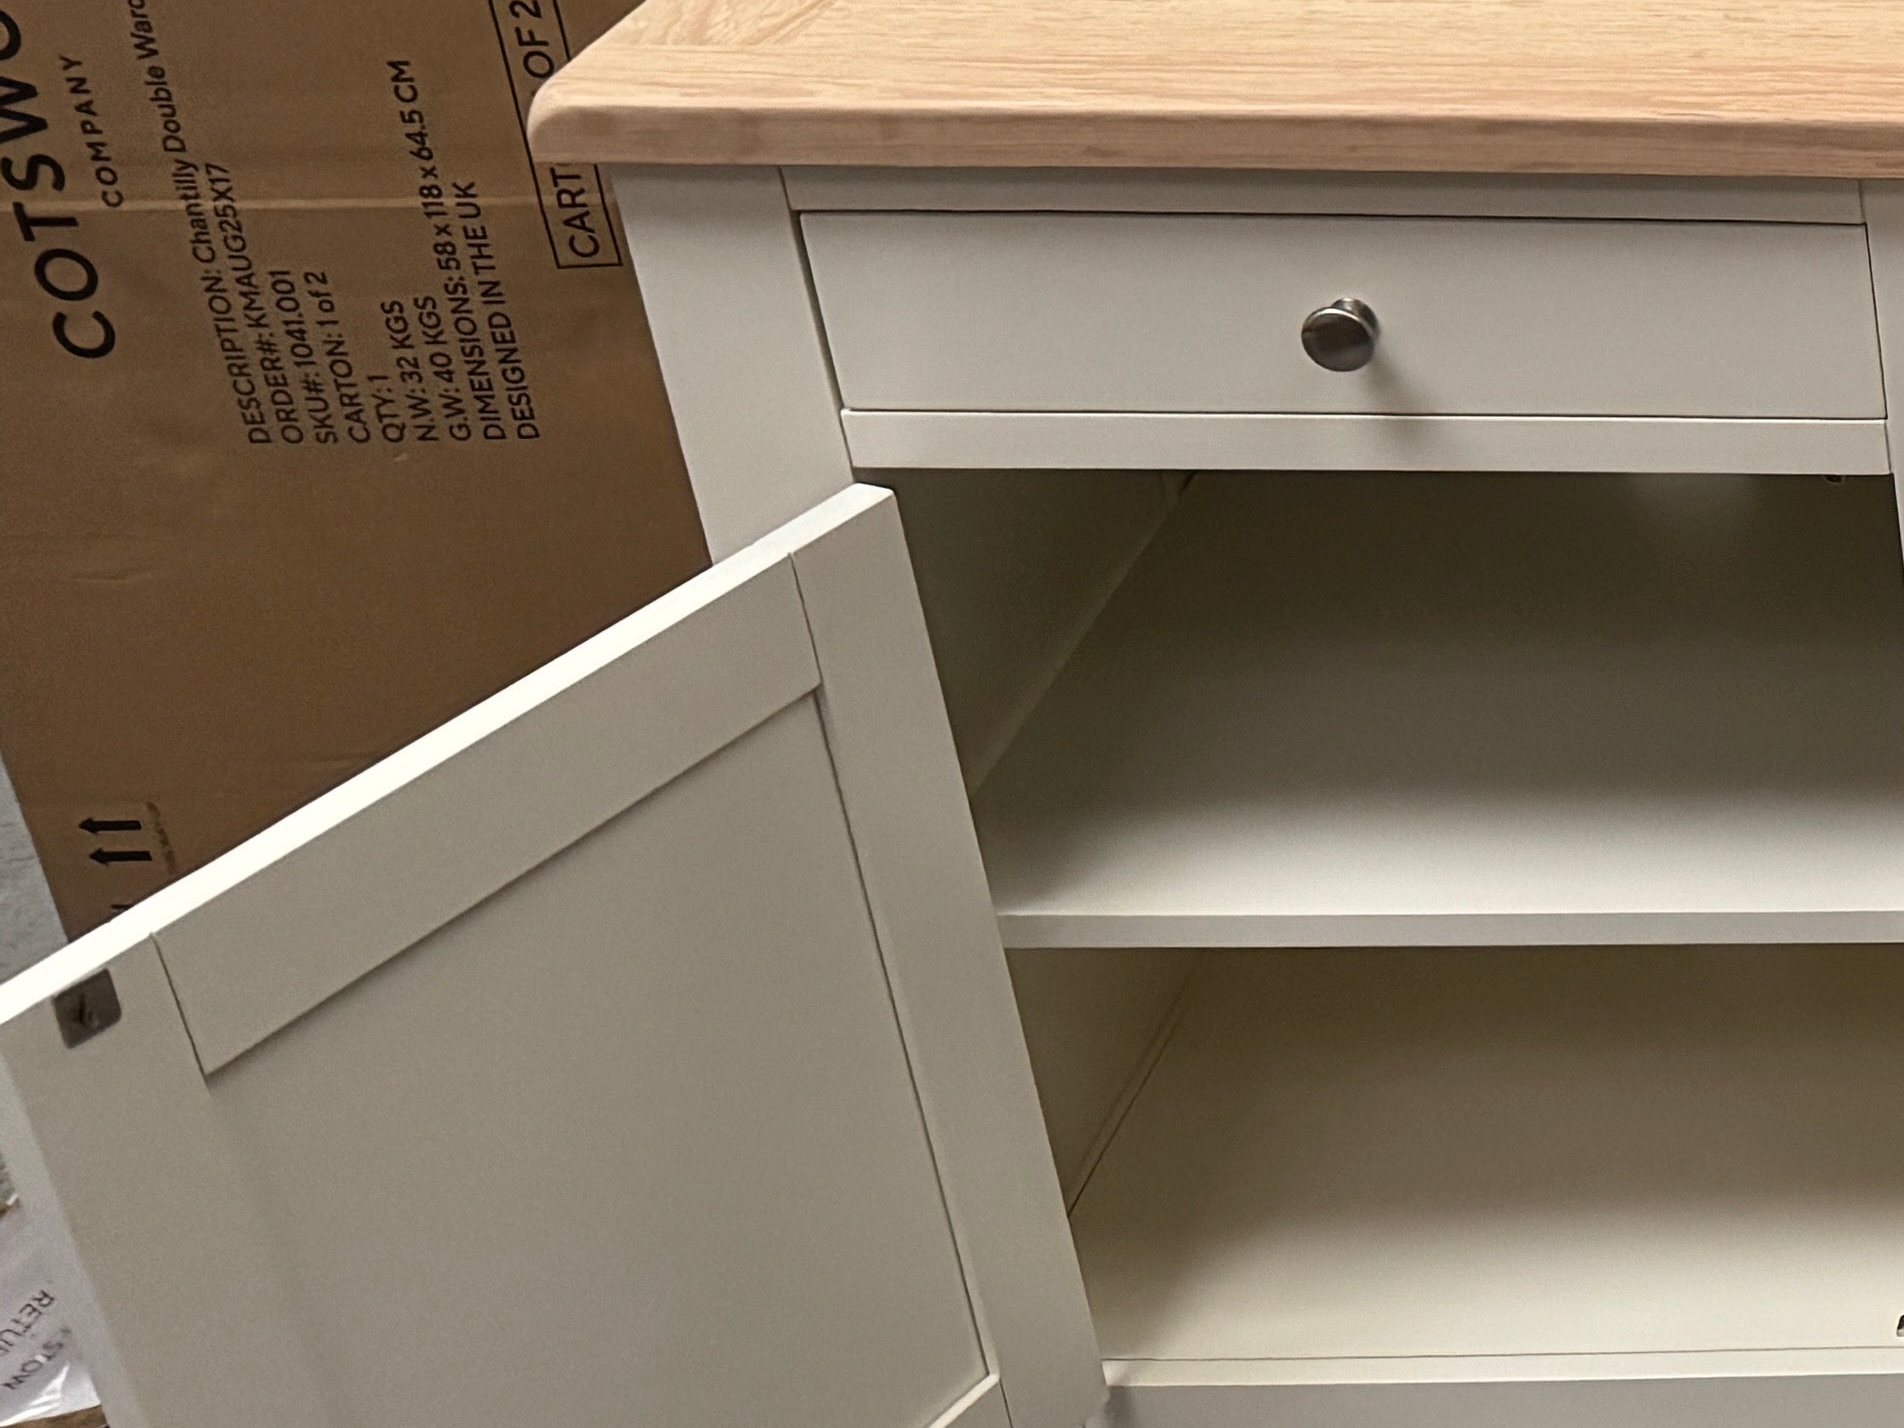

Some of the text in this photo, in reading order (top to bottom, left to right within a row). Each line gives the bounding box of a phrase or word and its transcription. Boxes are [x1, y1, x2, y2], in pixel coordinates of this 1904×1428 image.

[387, 59, 419, 104] CM
[514, 26, 555, 81] OF
[59, 54, 124, 208] COMPANY
[145, 65, 186, 153] Double
[401, 109, 434, 160] 64.5
[171, 159, 216, 264] Chantilly
[419, 184, 448, 219] 118
[304, 271, 328, 285] 2
[308, 290, 335, 313] of
[433, 241, 461, 272] 58
[200, 269, 272, 444] DESCRIPTION:
[444, 274, 507, 441] DIMENSIONS:
[452, 180, 540, 441] DESIGNED IN THE UK
[322, 332, 372, 444] CARTON:
[381, 299, 439, 442] N.W: 32 KGS
[414, 295, 472, 442] G.W: 40 KGS
